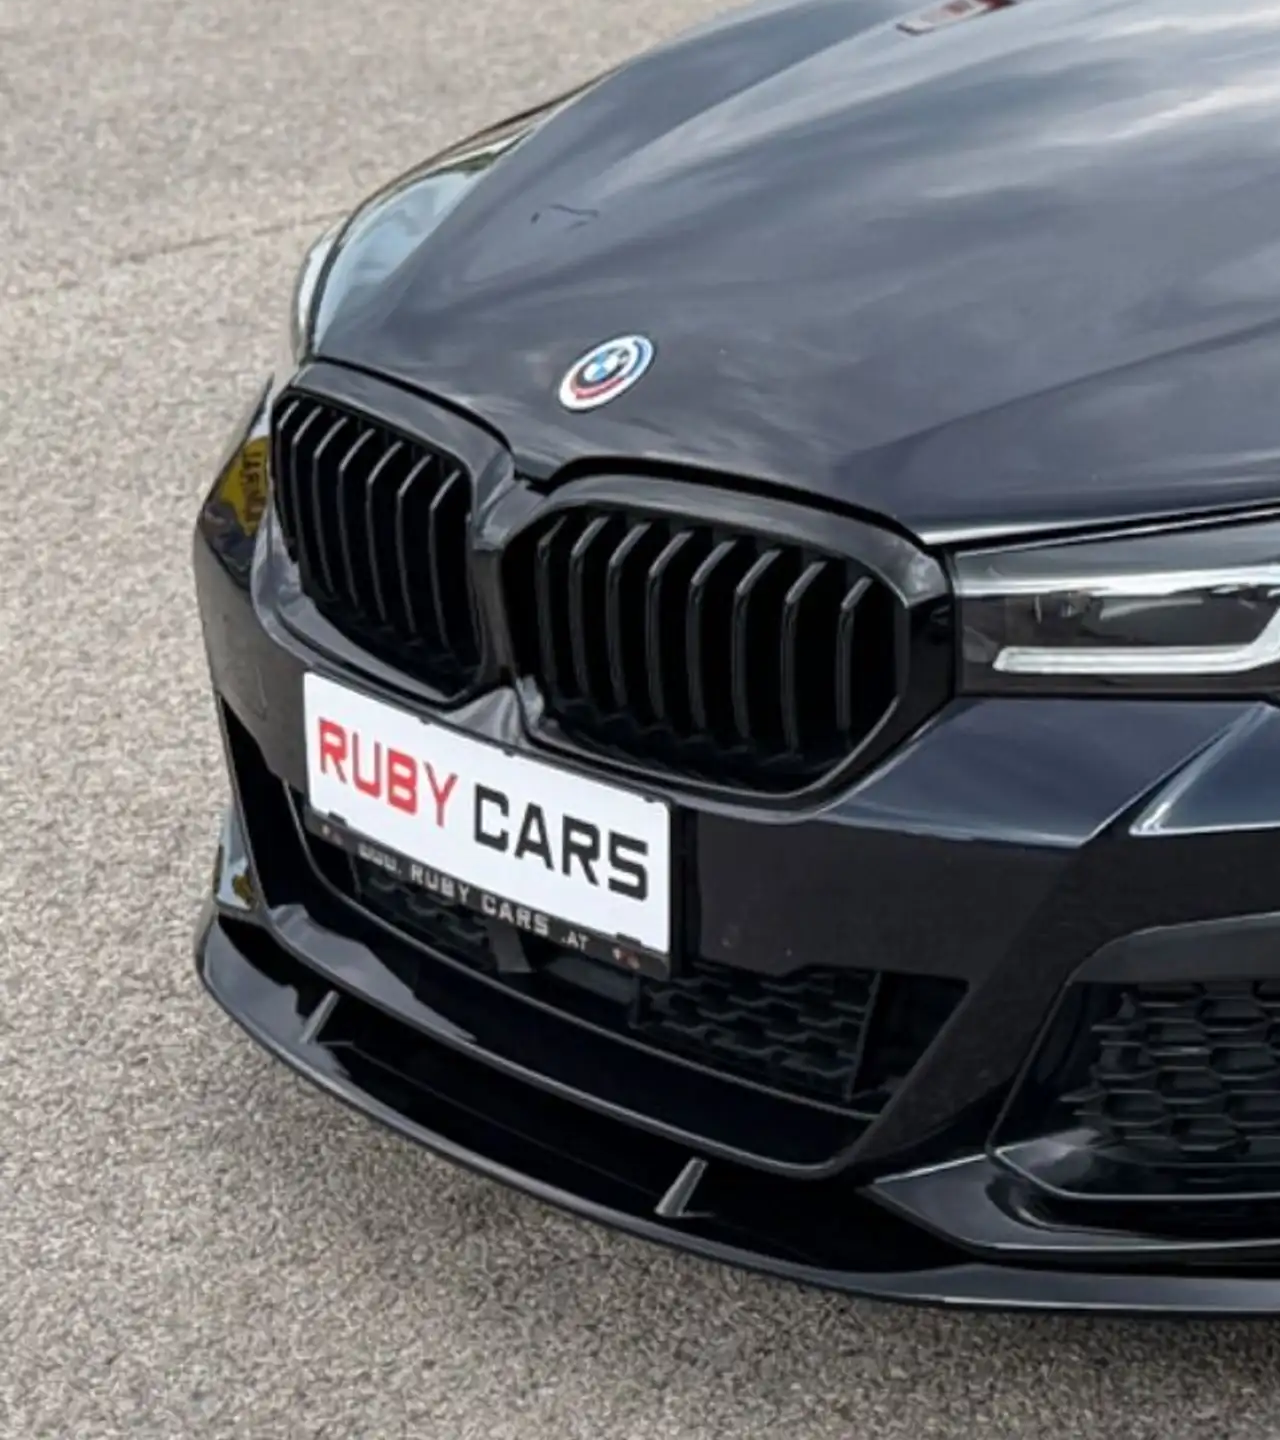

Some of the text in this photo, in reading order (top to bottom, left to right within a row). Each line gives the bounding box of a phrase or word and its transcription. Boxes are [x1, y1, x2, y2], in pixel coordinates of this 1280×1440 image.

[317, 716, 650, 902] RUBY CARS
[410, 862, 471, 905] RUBY
[480, 893, 550, 937] CARS
